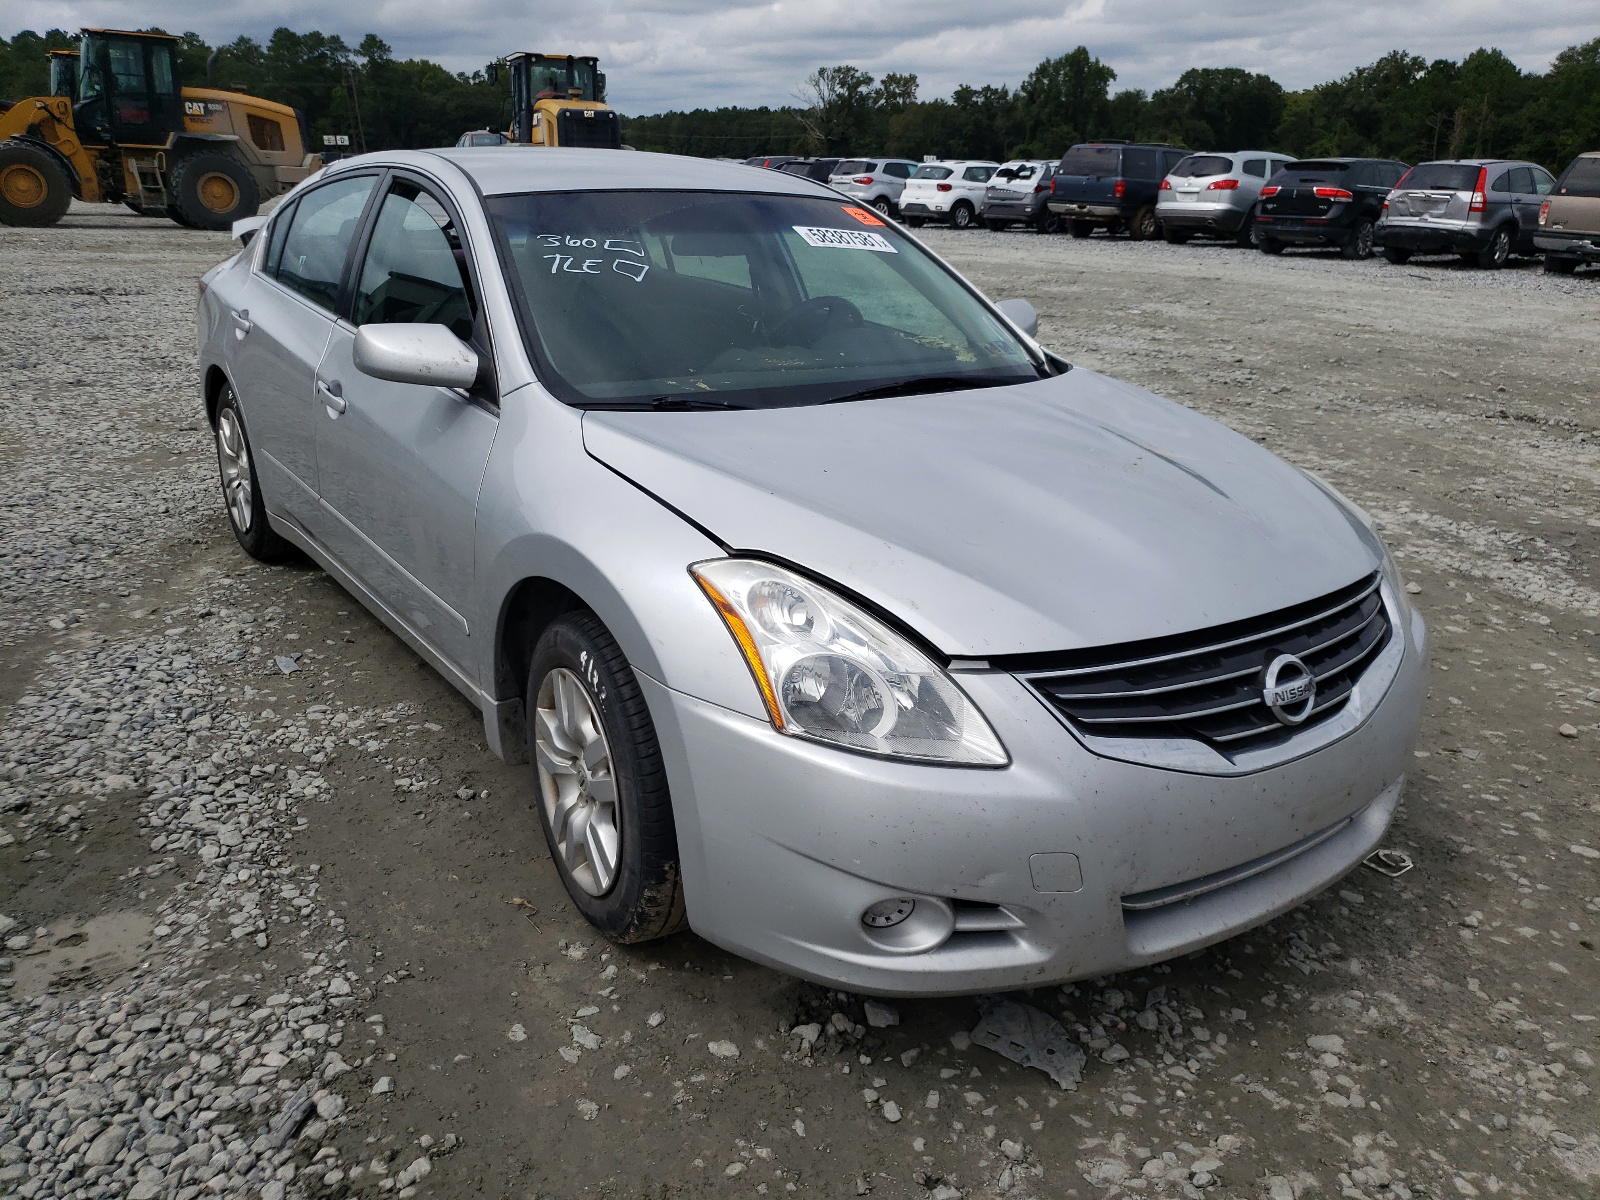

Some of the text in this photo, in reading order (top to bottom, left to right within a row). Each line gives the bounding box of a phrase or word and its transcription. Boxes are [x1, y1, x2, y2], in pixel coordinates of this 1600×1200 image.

[184, 101, 205, 114] CAT
[536, 234, 597, 248] 360
[807, 228, 882, 247] 58387581
[1273, 682, 1316, 702] NISSAN
